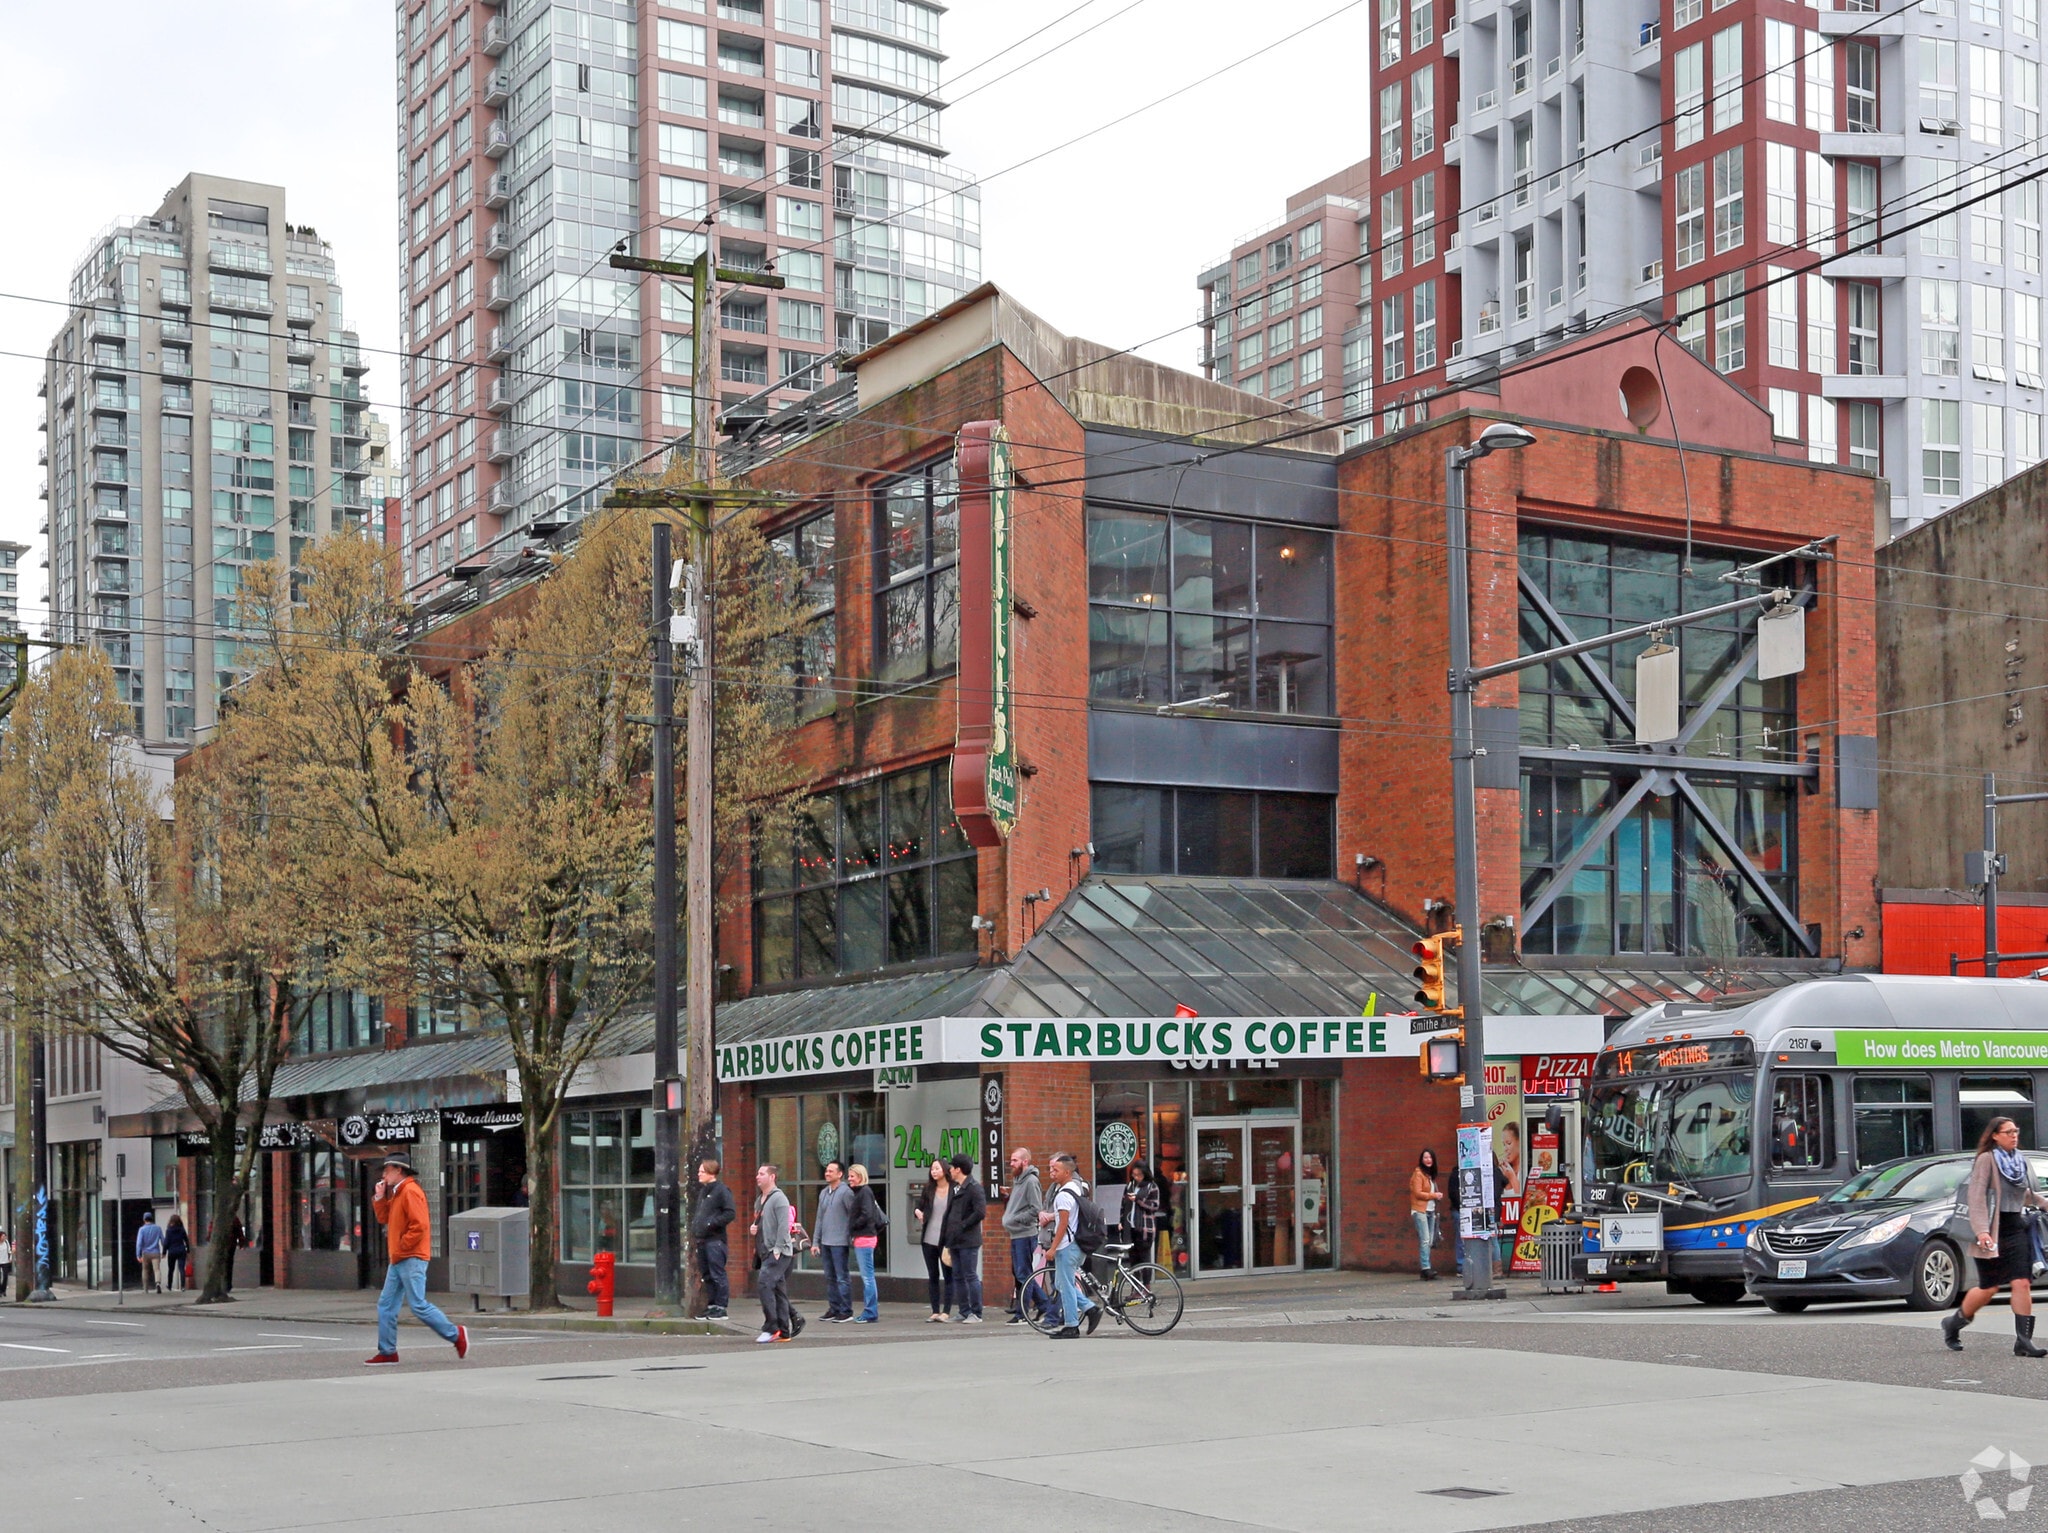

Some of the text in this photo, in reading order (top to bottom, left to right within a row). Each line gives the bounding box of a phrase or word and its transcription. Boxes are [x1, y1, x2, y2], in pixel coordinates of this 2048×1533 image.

[1412, 1019, 1438, 1033] Smithe
[831, 1025, 923, 1068] COFFEE
[980, 1021, 1387, 1058] STARBUCKS COFFEE
[1789, 1038, 1808, 1050] 2187
[1864, 1039, 1896, 1058] How
[1902, 1039, 1936, 1058] does
[1941, 1040, 1980, 1058] Metro
[1618, 1051, 1632, 1074] 14
[1659, 1045, 1709, 1067] HASTINGS
[878, 1067, 913, 1084] ATM
[1535, 1056, 1588, 1078] PIZZA
[1506, 1075, 1516, 1083] and
[453, 1111, 524, 1125] Roadhouse
[376, 1127, 415, 1140] OPEN
[1101, 1124, 1135, 1145] STARBUCKS
[938, 1127, 980, 1165] ATM
[989, 1129, 999, 1198] OPEN
[1105, 1154, 1131, 1166] COFFEE
[1590, 1189, 1607, 1201] 2187
